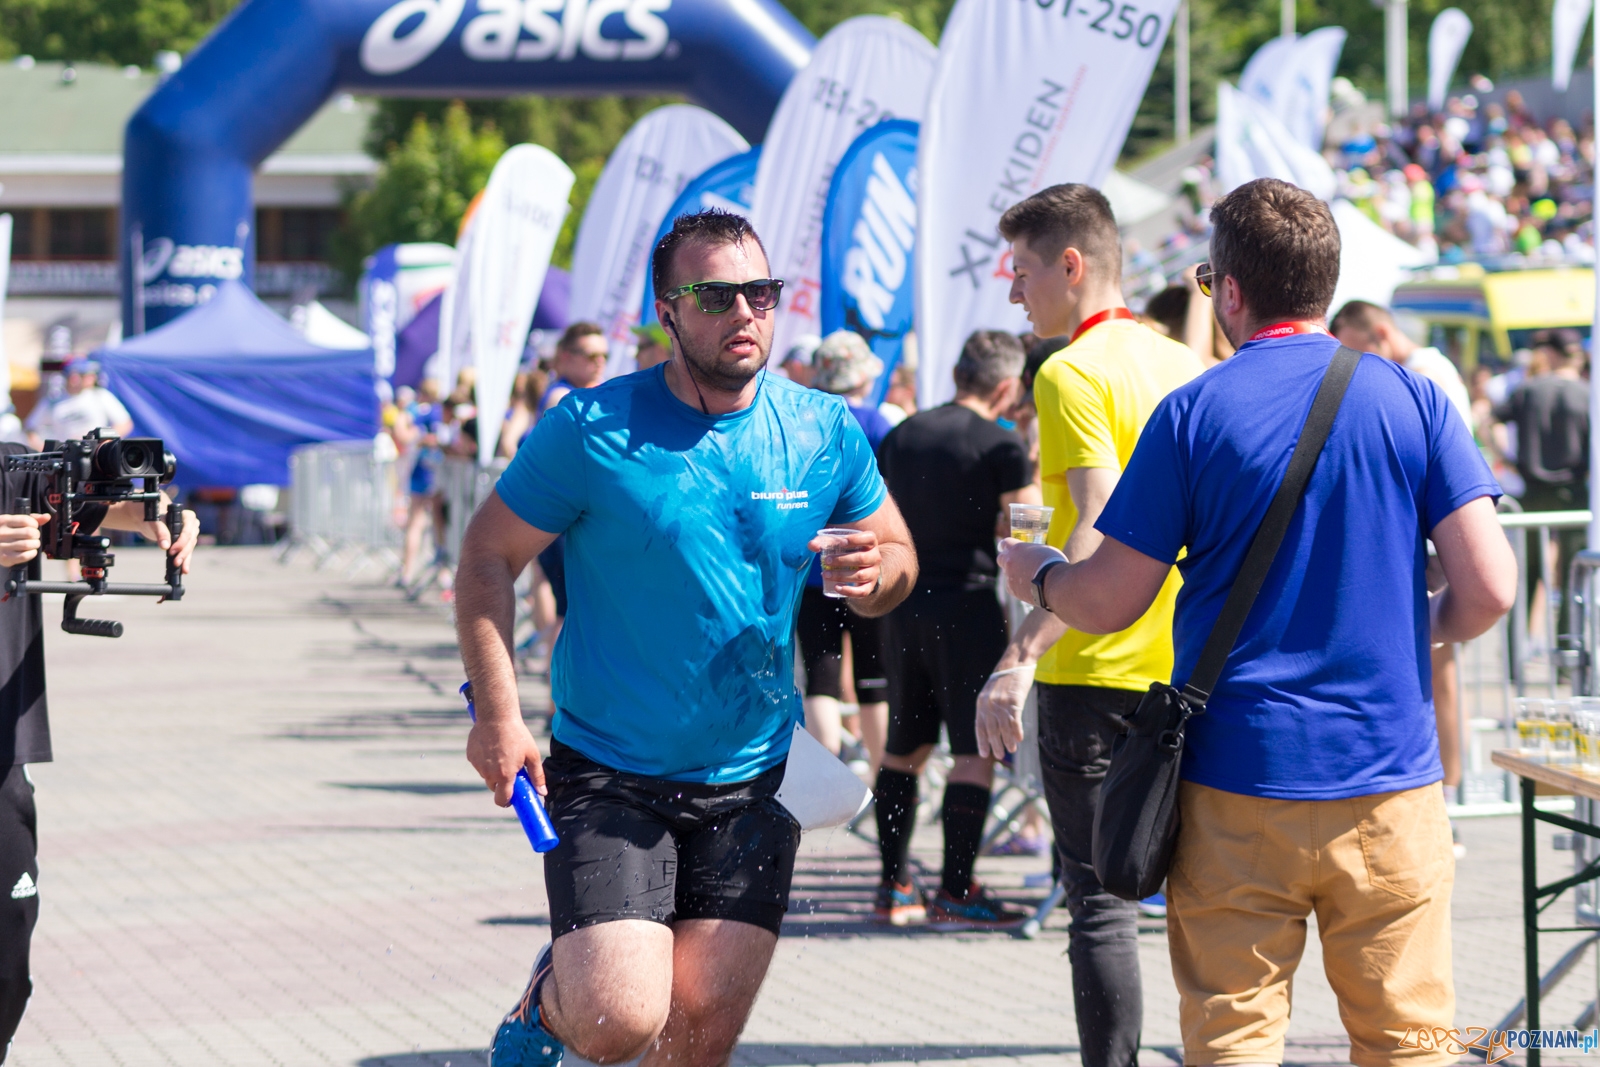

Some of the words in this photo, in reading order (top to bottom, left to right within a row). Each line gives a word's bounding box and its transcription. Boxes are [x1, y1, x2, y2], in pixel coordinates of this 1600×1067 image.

[460, 0, 671, 61] asics
[751, 490, 784, 500] biuro
[786, 490, 808, 501] plus
[776, 501, 809, 510] runners
